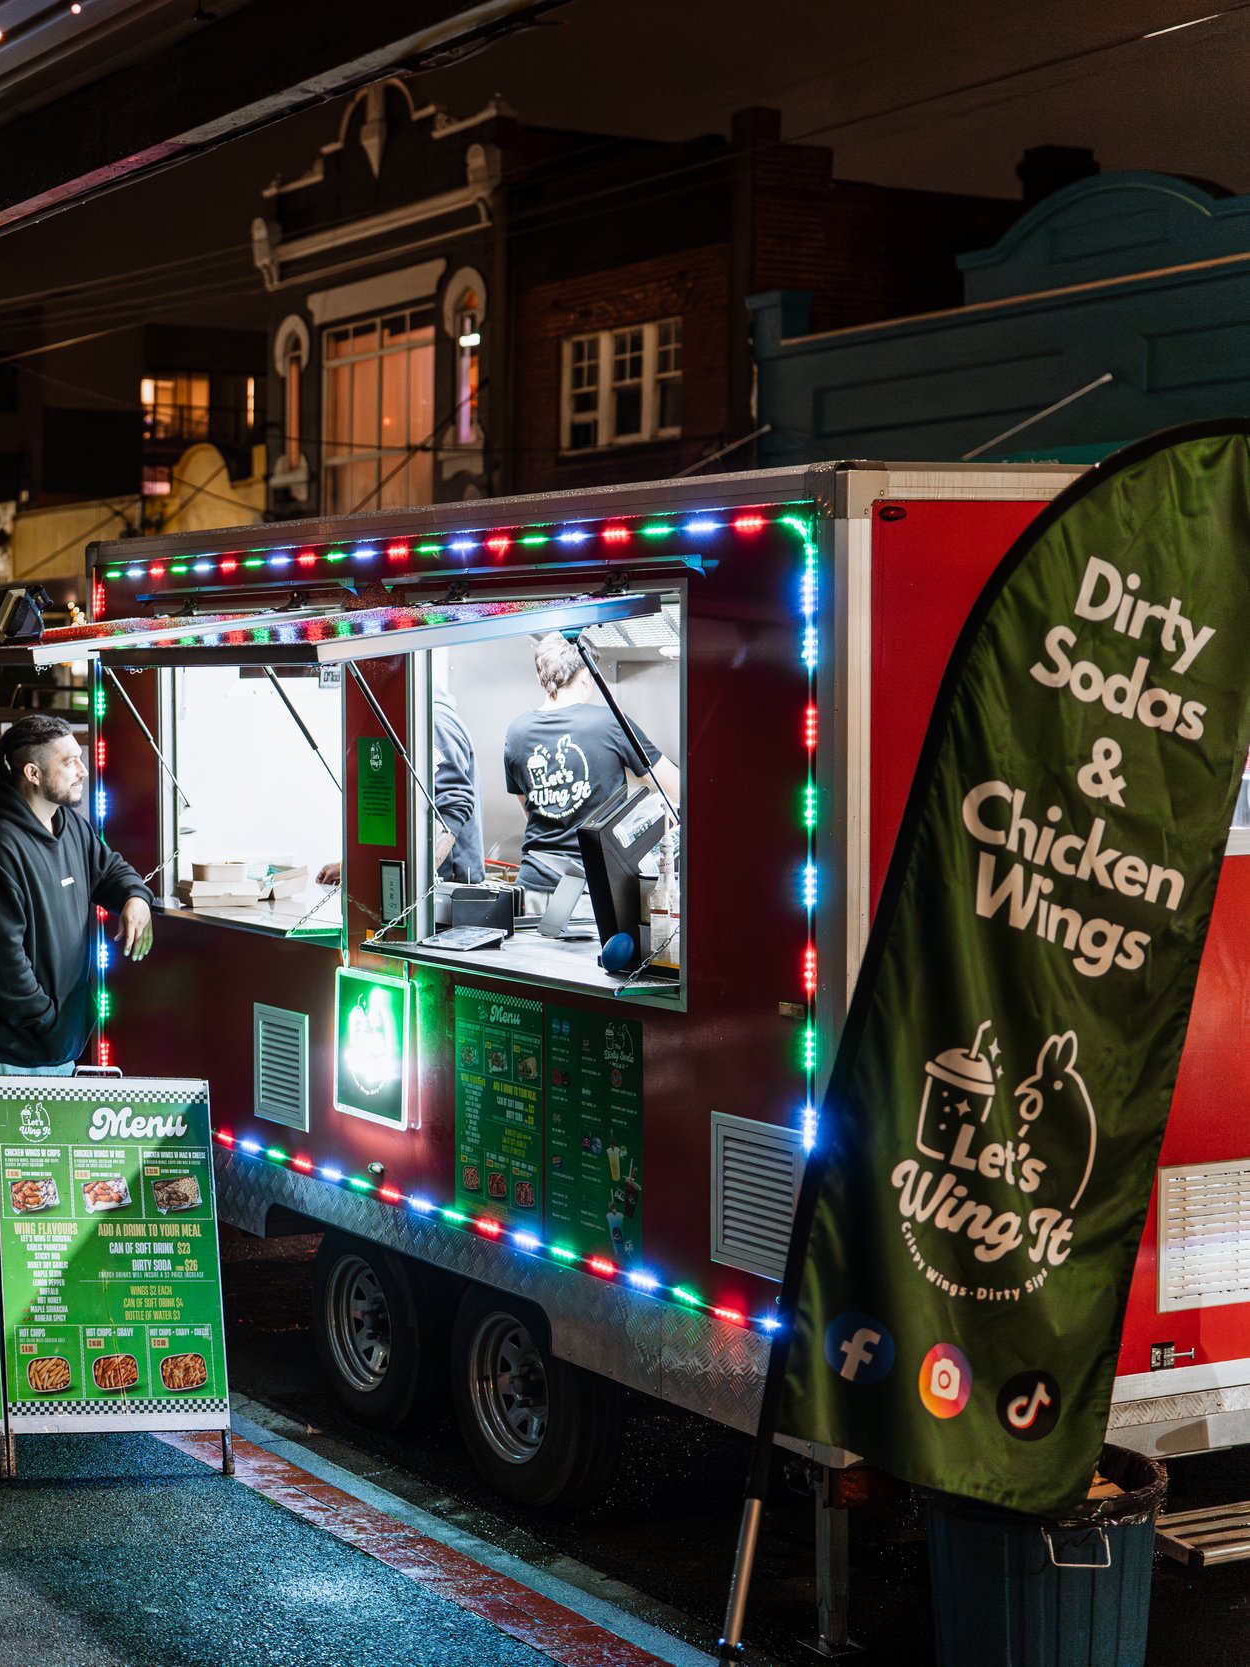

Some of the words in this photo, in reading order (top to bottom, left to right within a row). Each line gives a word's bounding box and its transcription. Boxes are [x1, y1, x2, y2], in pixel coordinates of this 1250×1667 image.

[1074, 556, 1216, 675] Dirty
[1030, 624, 1207, 742] Sodas
[541, 769, 574, 788] Let's
[1077, 738, 1126, 807] &
[529, 788, 570, 807] Wing
[572, 780, 591, 800] It
[962, 780, 1186, 911] Chicken
[975, 851, 1151, 977] Wings
[490, 1004, 520, 1025] Menu
[19, 1126, 42, 1137] Wing
[42, 1126, 52, 1136] It
[89, 1107, 188, 1140] Menu
[950, 1122, 1048, 1195] Let's
[890, 1158, 1024, 1263] Wing
[1026, 1203, 1074, 1268] It
[14, 1222, 36, 1234] WING
[38, 1222, 78, 1235] FLAVOURS
[98, 1224, 114, 1236] ADD
[116, 1224, 122, 1236] A
[123, 1224, 146, 1236] DRINK
[148, 1224, 158, 1236] TO
[160, 1224, 180, 1236] YOUR
[182, 1224, 202, 1237] MEAL
[110, 1242, 124, 1254] CAN
[125, 1242, 134, 1254] OF
[135, 1242, 152, 1254] SOFT
[154, 1242, 174, 1254] DRINK
[178, 1242, 190, 1255] $23
[132, 1260, 152, 1271] DIRTY
[154, 1260, 172, 1271] SODA
[184, 1258, 198, 1272] $26
[901, 1221, 926, 1271] Crispy
[926, 1266, 967, 1297] Wings
[976, 1287, 1020, 1302] Dirty
[1025, 1268, 1048, 1294] Sips
[130, 1286, 148, 1295] WINGS
[150, 1285, 156, 1296] $2
[158, 1286, 172, 1295] EACH
[124, 1298, 136, 1308] CAN
[136, 1298, 143, 1308] OF
[144, 1298, 157, 1308] SOFT
[158, 1298, 175, 1308] DRINK
[176, 1297, 184, 1308] $4
[125, 1310, 144, 1320] BOTTLE
[146, 1310, 152, 1320] OF
[152, 1310, 172, 1320] WATER
[173, 1310, 180, 1320] $3
[19, 1328, 28, 1337] HOT
[30, 1328, 46, 1337] CHIPS
[86, 1328, 96, 1336] HOT
[96, 1328, 112, 1336] CHIPS
[116, 1328, 134, 1336] GRAVY
[150, 1328, 158, 1336] HOT
[159, 1328, 172, 1336] CHIPS
